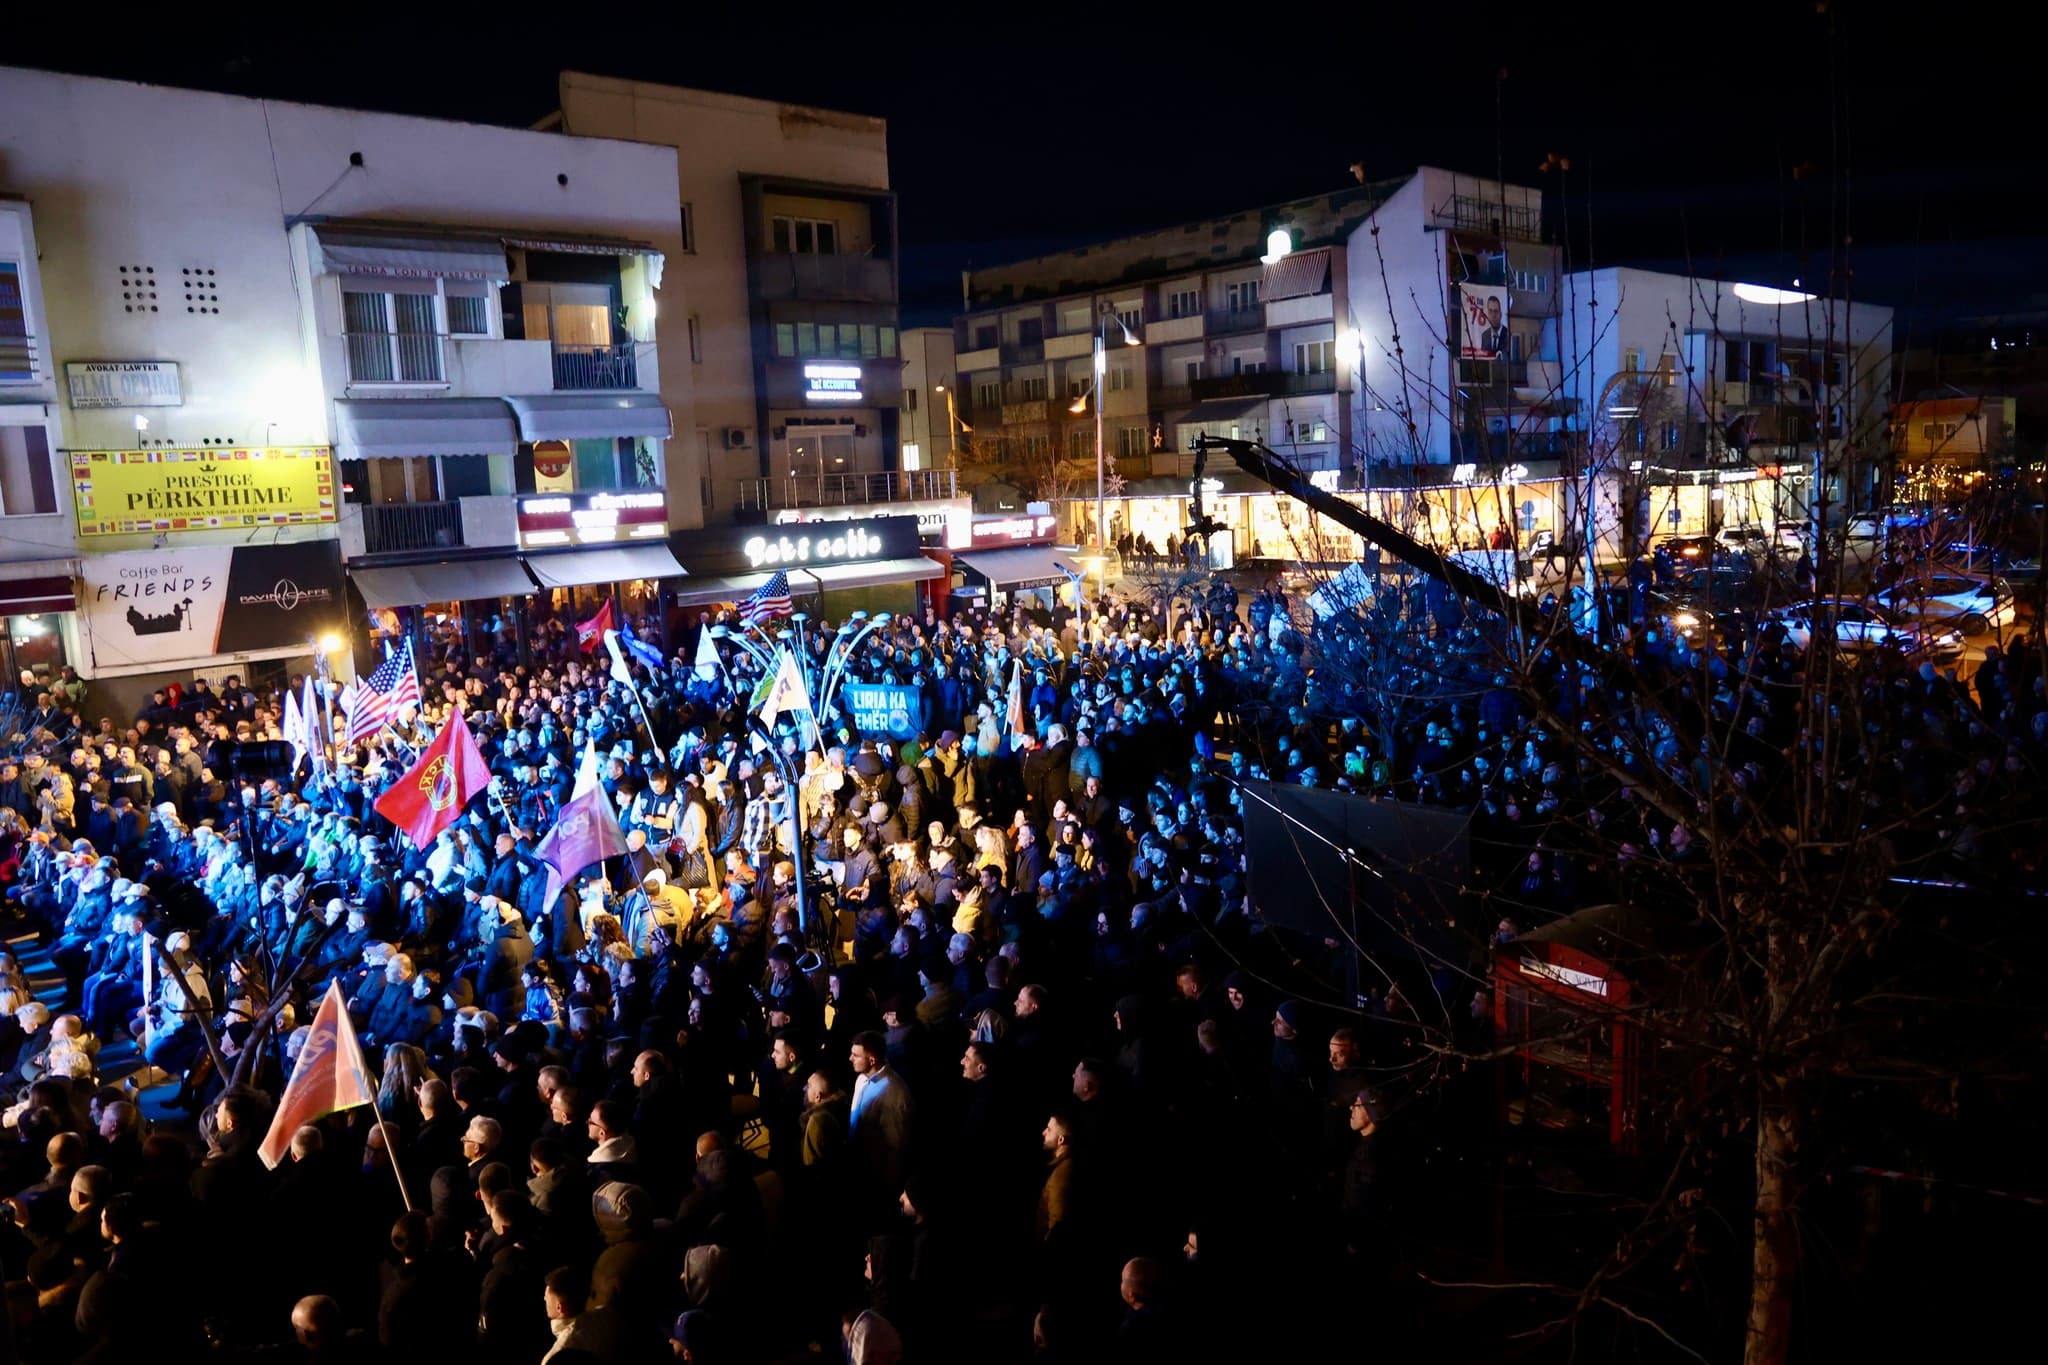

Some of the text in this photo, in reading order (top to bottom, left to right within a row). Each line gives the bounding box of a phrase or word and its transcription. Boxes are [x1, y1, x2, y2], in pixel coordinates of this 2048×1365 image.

[166, 474, 253, 489] PRESTIGE
[127, 487, 293, 510] PËRKTHIME
[120, 565, 184, 579] Caffe Bar
[97, 576, 213, 602] FRIENDS
[853, 690, 907, 709] LIRIA KA
[854, 709, 888, 731] EMËR
